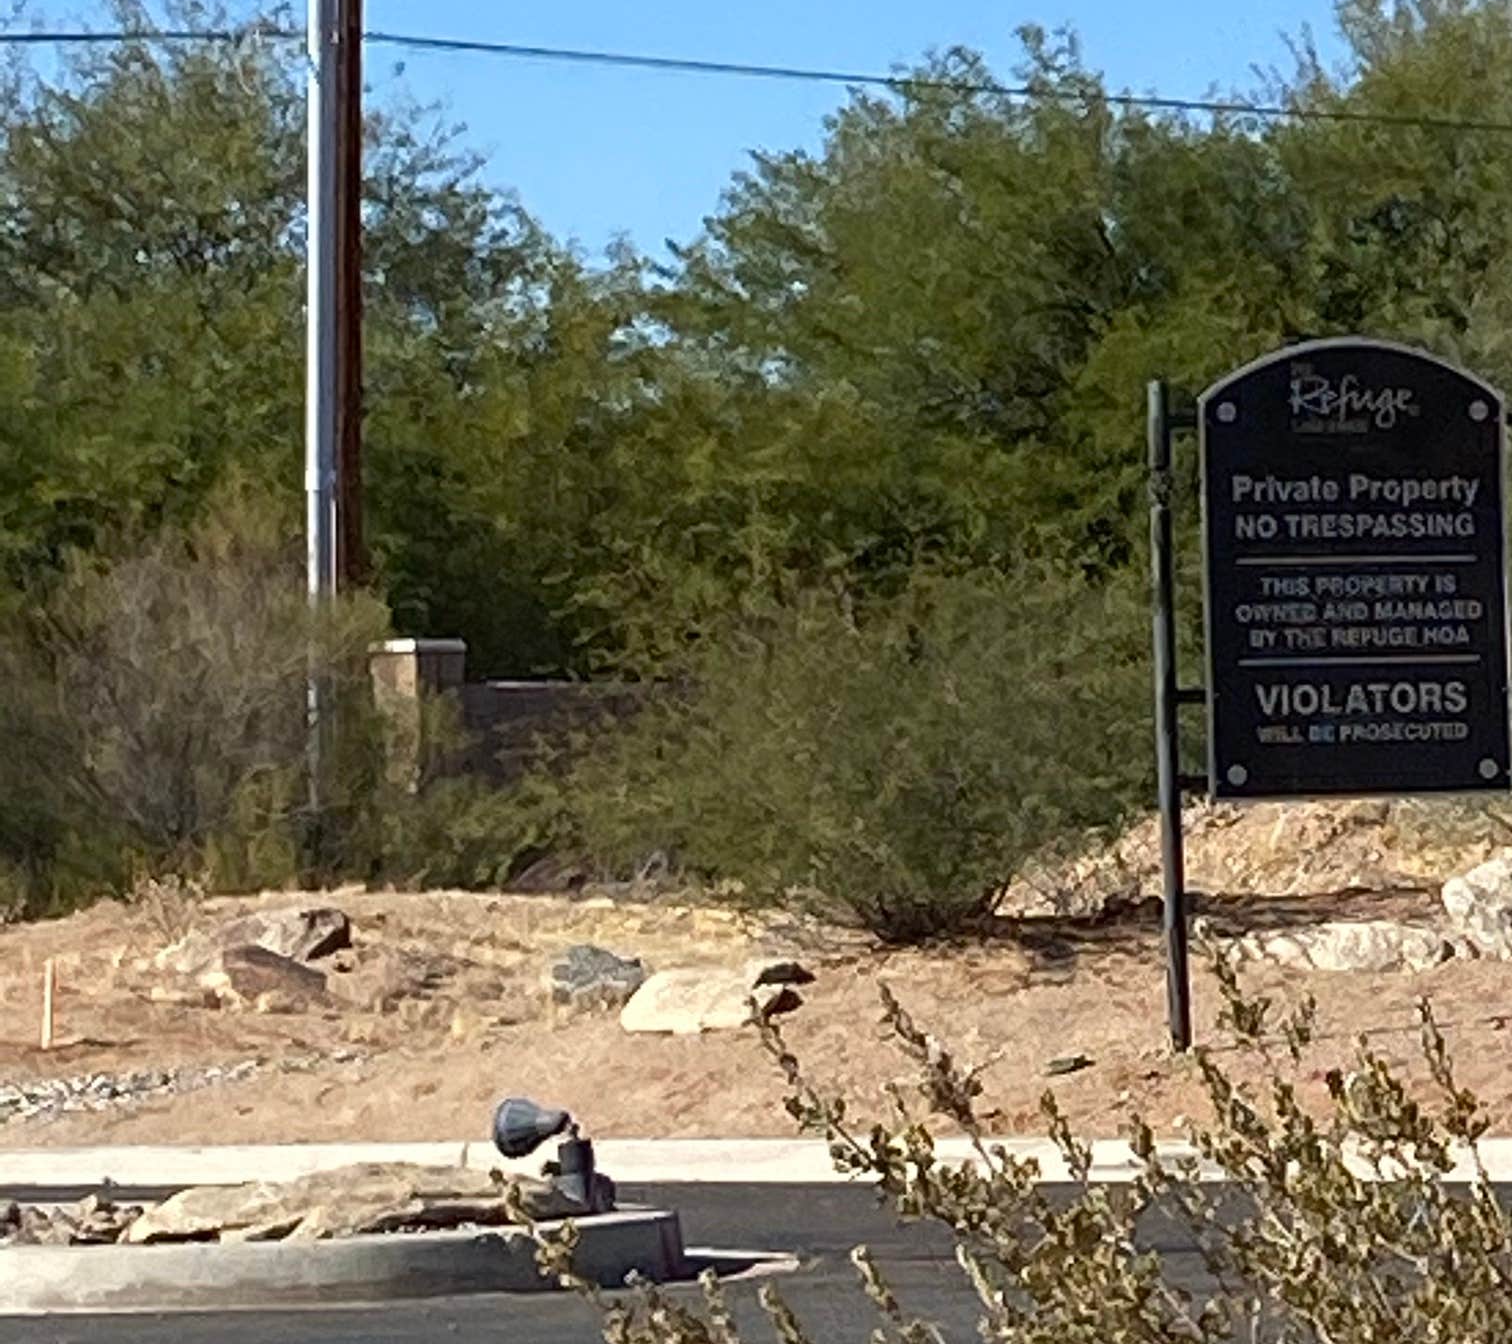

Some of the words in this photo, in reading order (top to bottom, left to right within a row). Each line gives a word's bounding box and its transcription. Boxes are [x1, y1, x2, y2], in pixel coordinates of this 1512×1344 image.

[1232, 476, 1339, 503] Private
[1349, 474, 1481, 506] Property
[1235, 515, 1278, 539] NO
[1284, 513, 1475, 537] TRESPASSING
[1260, 577, 1310, 596] THIS
[1314, 576, 1429, 596] PROPERTY
[1434, 575, 1456, 593] IS
[1235, 603, 1317, 623] OWNED
[1322, 602, 1368, 621] AND
[1374, 600, 1482, 620] MANAGED
[1249, 629, 1276, 648] BY
[1283, 629, 1326, 649] THE
[1331, 628, 1420, 647] REFUGE
[1423, 626, 1470, 645] HOA
[1255, 682, 1468, 716] VIOLATORS
[1257, 725, 1305, 744] WILL
[1309, 725, 1335, 742] BE
[1339, 722, 1469, 741] PROSECUTED
